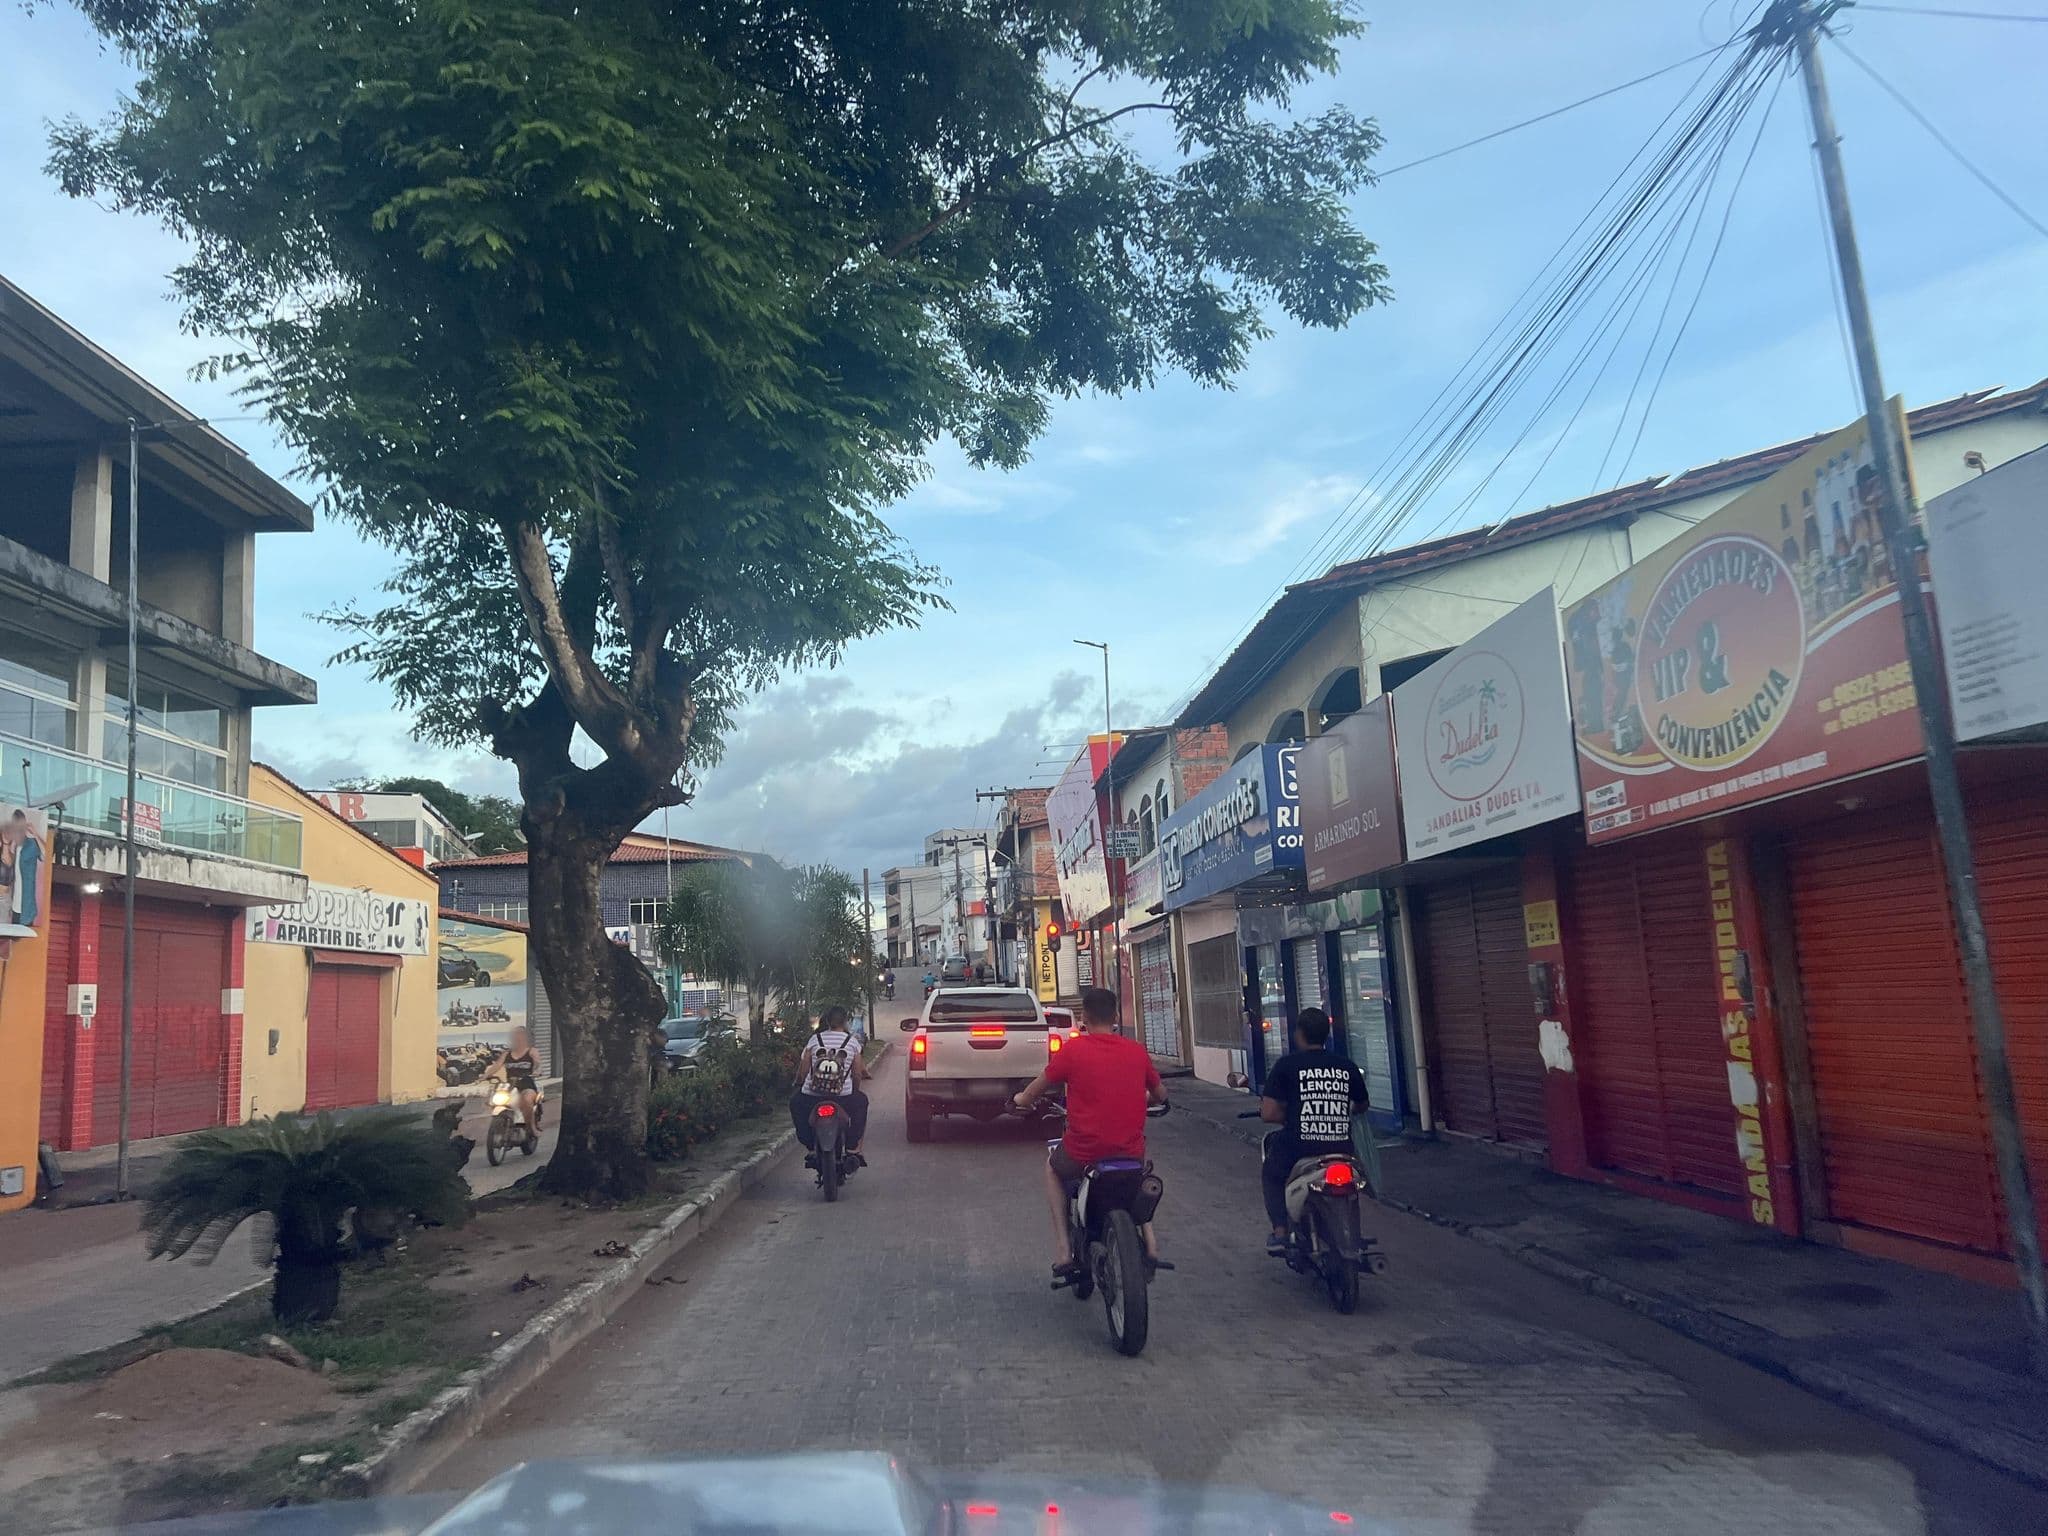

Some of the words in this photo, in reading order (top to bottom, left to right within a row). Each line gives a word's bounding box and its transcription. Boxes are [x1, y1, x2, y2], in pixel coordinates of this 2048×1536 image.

[1653, 648, 1692, 703] VIP
[1698, 620, 1733, 695] &
[1657, 668, 1791, 759] CONVENIÊNCIA
[1314, 817, 1360, 852] ARMARINHO
[1363, 808, 1381, 832] SOL
[276, 923, 342, 947] APARTIR
[345, 931, 362, 949] DE
[1042, 943, 1051, 983] NETPOINT
[1299, 1079, 1350, 1093] LENÇÓIS
[1301, 1100, 1348, 1116] ATINS
[1300, 1122, 1350, 1134] SADLER
